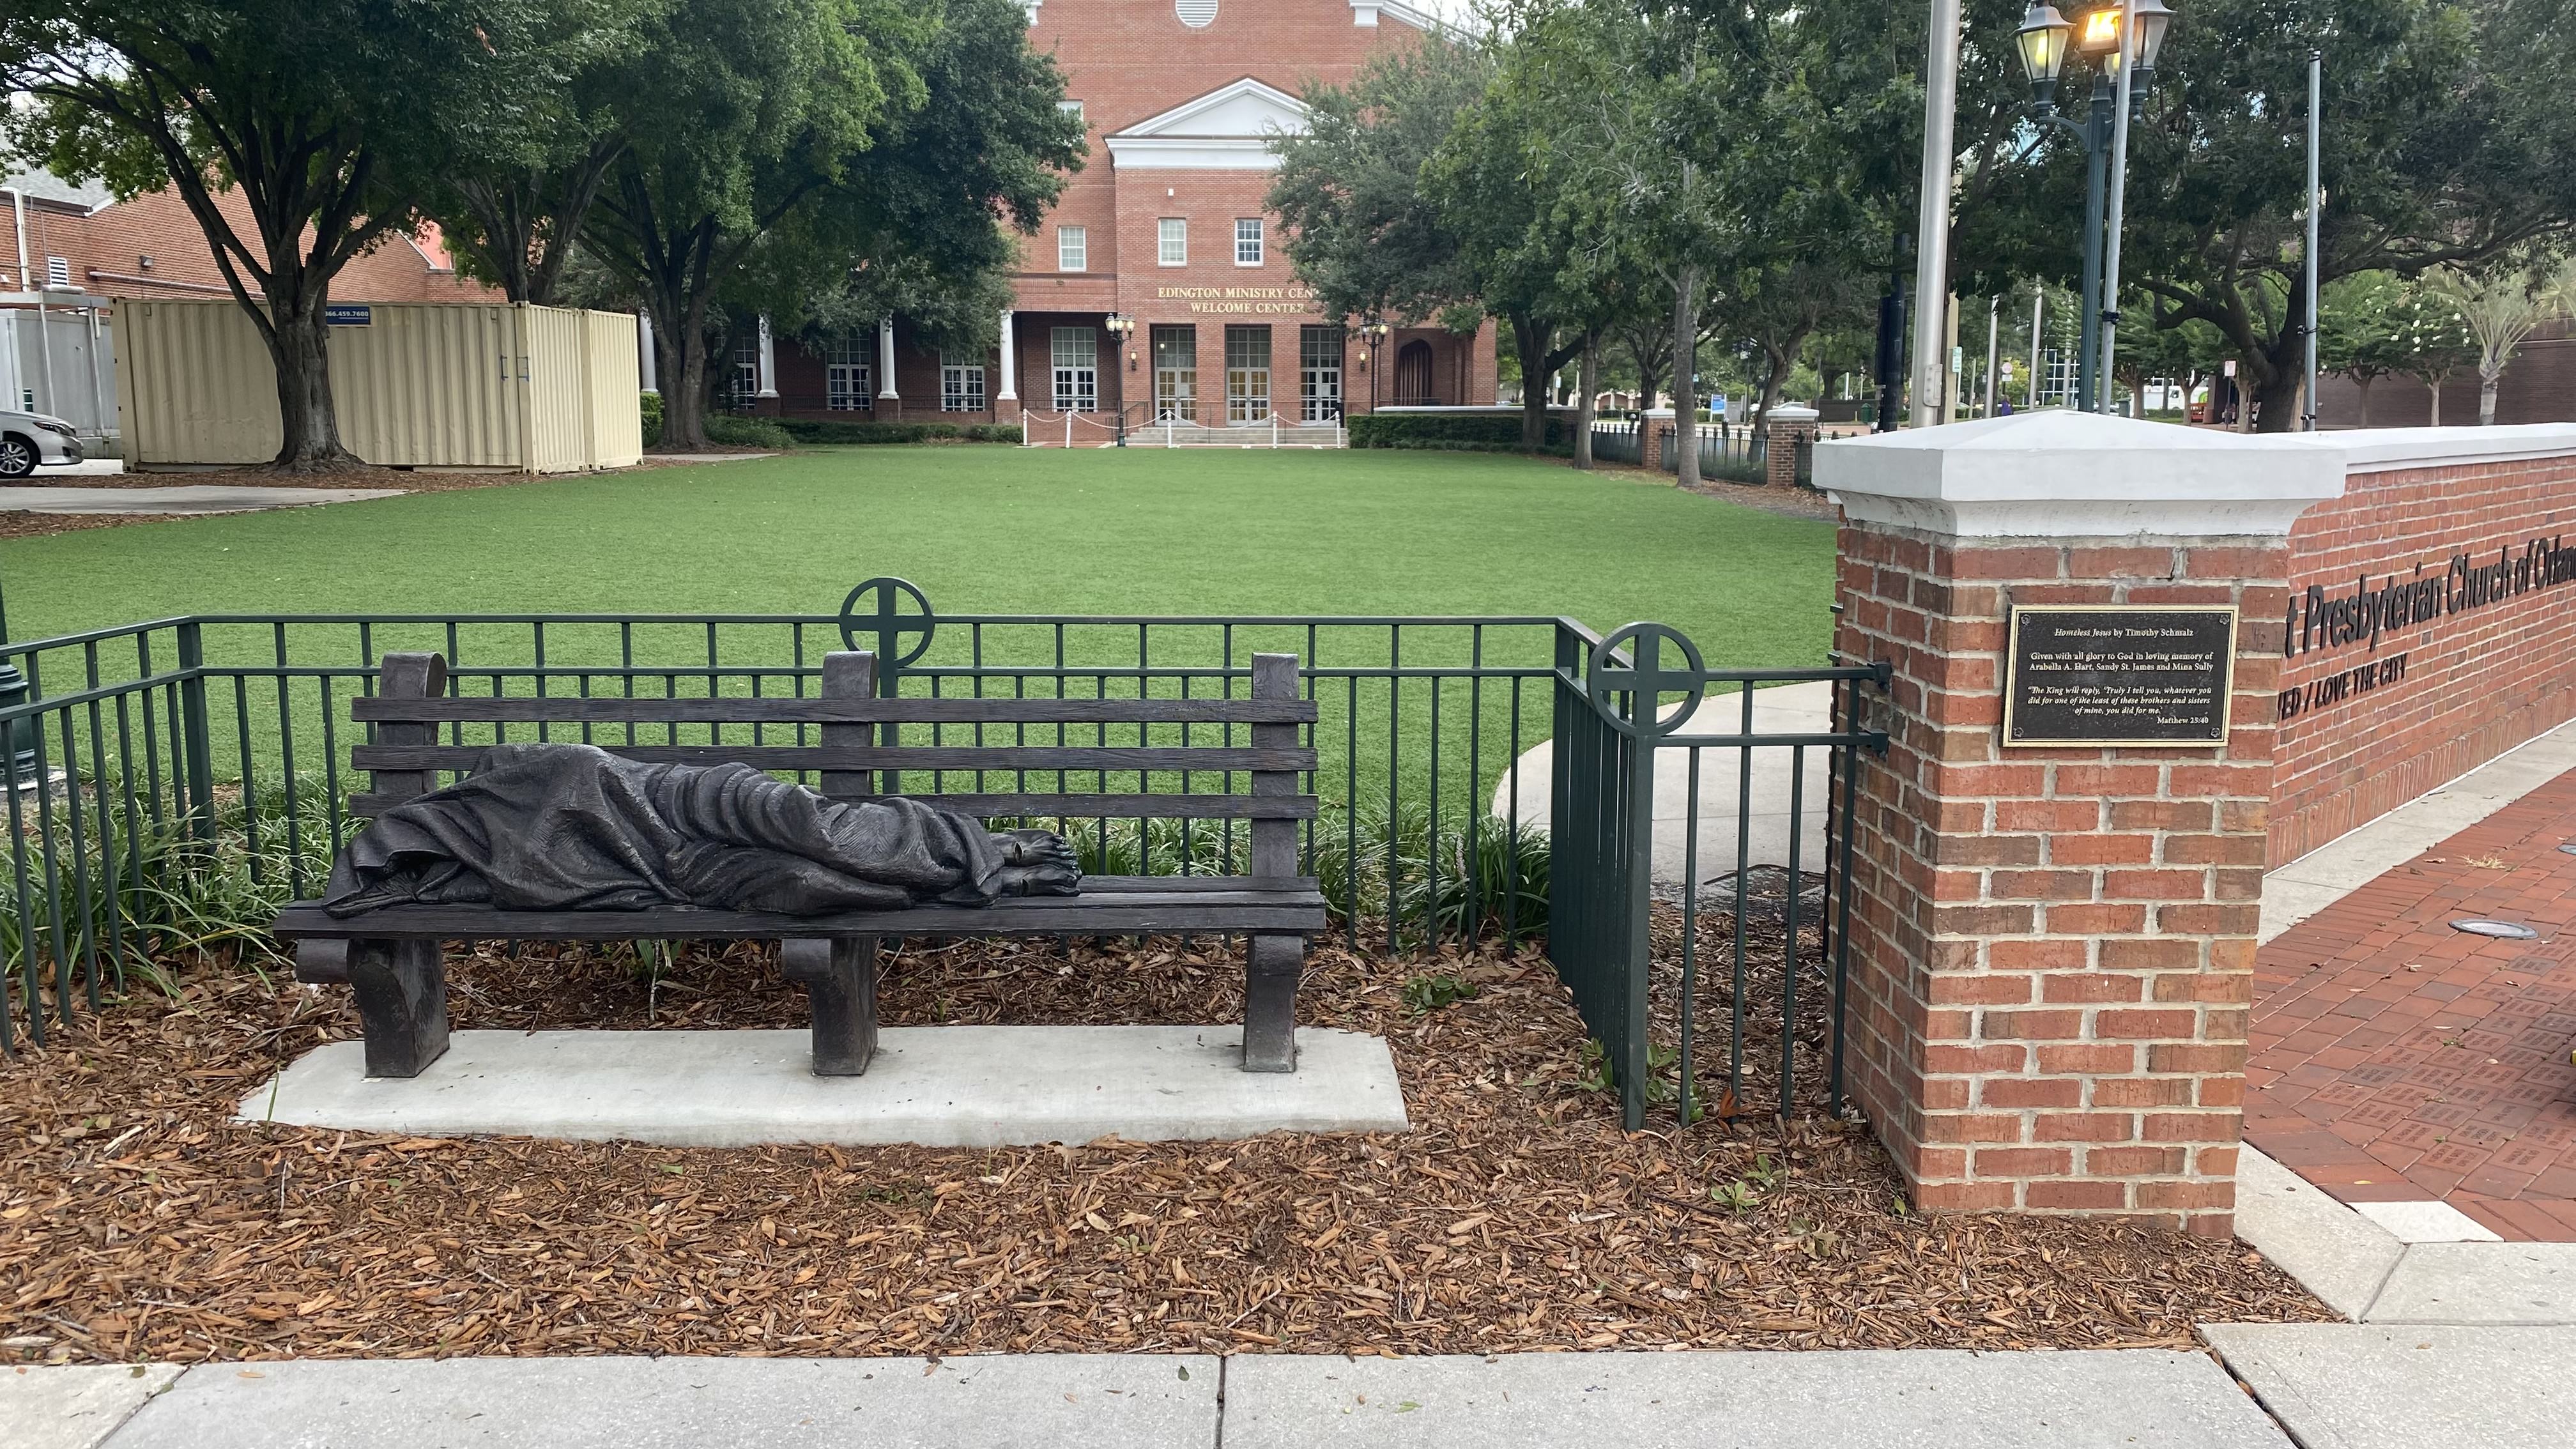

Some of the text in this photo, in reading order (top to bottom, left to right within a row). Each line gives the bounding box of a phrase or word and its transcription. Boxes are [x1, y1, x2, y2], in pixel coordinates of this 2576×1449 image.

[1158, 288, 1220, 298] EDINGTON
[1225, 288, 1284, 298] MINISTRY
[1190, 303, 1252, 313] WELCOME
[2303, 561, 2442, 653] Presbyterian
[2446, 544, 2513, 615] Church
[2515, 539, 2535, 595] of
[2054, 628, 2194, 638] Homeless Jesus by Timothy Schmalz
[2030, 652, 2053, 660] Given
[2055, 651, 2072, 660] with
[2074, 651, 2084, 660] all
[2085, 651, 2106, 662] glory
[2117, 652, 2134, 660] God
[2136, 652, 2143, 660] in
[2145, 652, 2170, 662] loving
[2172, 654, 2203, 662] memory
[2205, 652, 2214, 660] of
[2029, 663, 2062, 671] Arabella
[2074, 663, 2094, 671] Hart,
[2096, 663, 2120, 672] Sandy
[2121, 663, 2130, 671] St.
[2133, 663, 2154, 671] James
[2156, 663, 2170, 671] and
[2195, 662, 2214, 672] Sully
[2314, 670, 2352, 709] LOVE
[2353, 662, 2379, 696] THE
[2379, 652, 2408, 686] CITY
[2046, 686, 2064, 695] King
[2066, 685, 2080, 694] will
[2082, 685, 2101, 695] reply,
[2041, 696, 2053, 705] for
[2070, 696, 2078, 705] of
[2111, 696, 2120, 705] of
[2074, 706, 2083, 716] of
[2083, 707, 2104, 715] mine,
[2135, 707, 2146, 716] for
